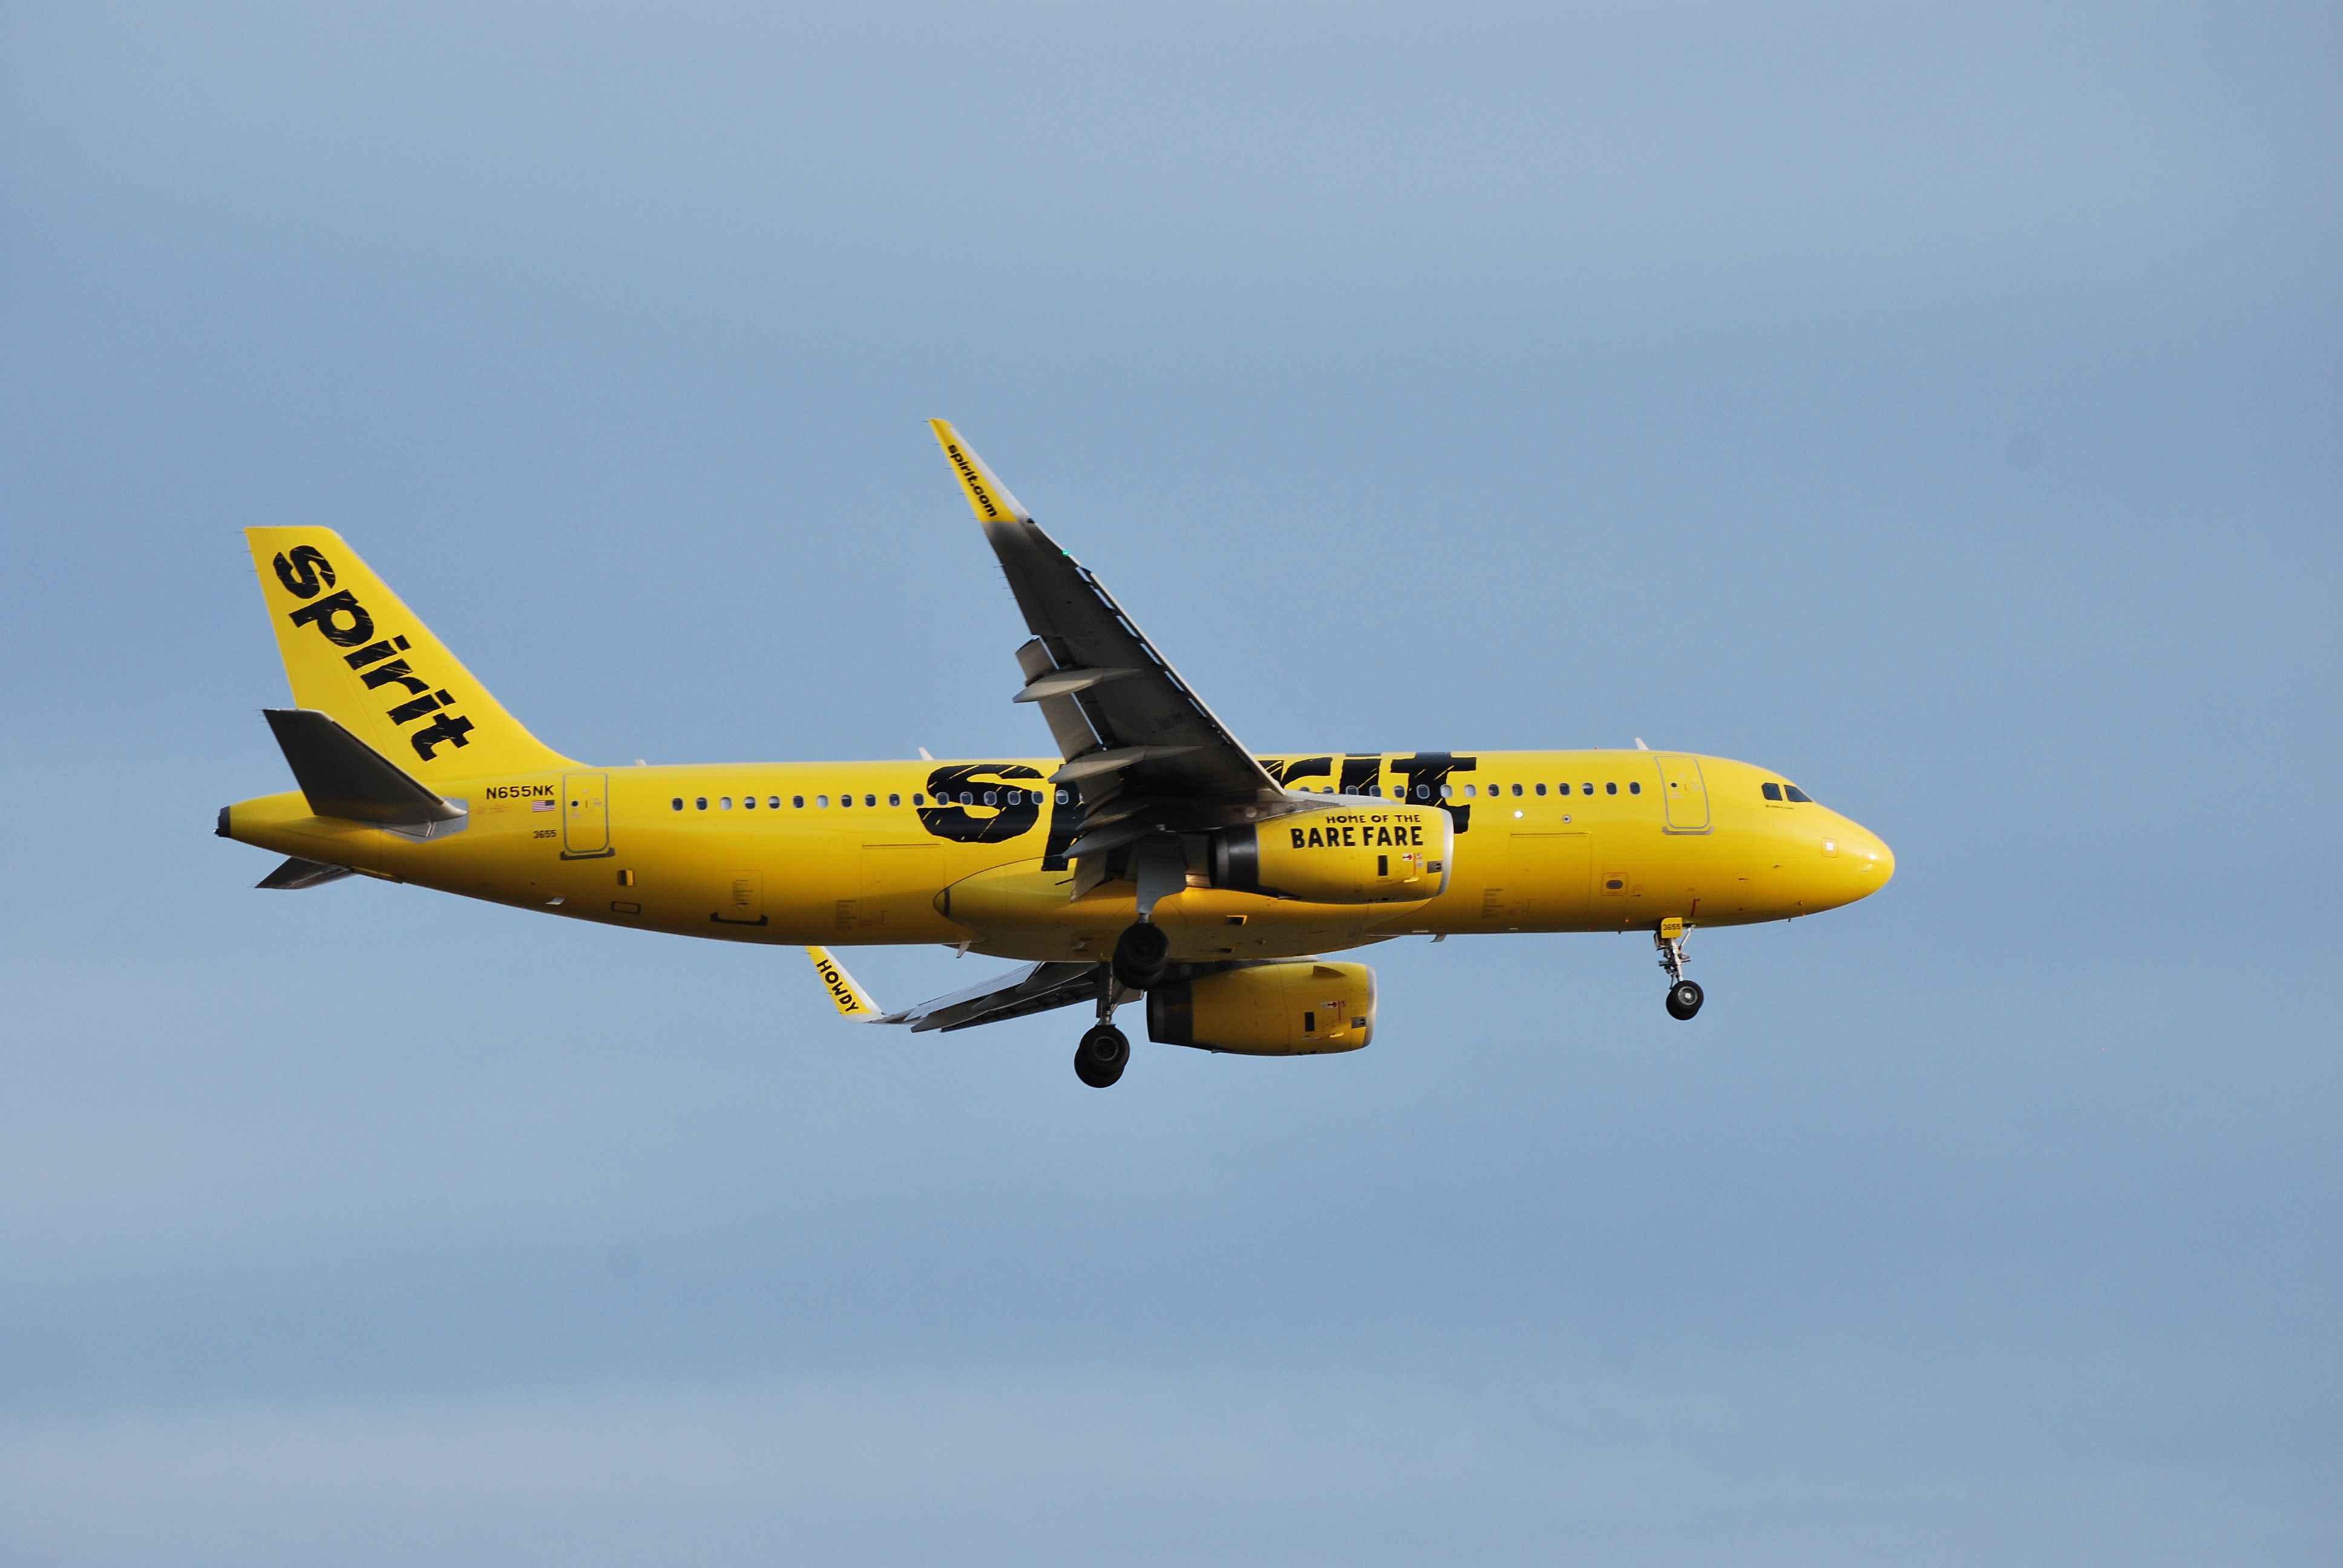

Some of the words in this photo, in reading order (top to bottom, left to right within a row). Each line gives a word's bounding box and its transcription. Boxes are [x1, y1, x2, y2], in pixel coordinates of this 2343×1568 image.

[947, 445, 997, 517] spirit.com
[273, 545, 474, 762] spirit
[487, 785, 554, 800] N655NK
[1326, 815, 1366, 824] HOME
[1371, 815, 1389, 823] OF
[1394, 814, 1421, 823] THE
[533, 829, 557, 838] 3655
[1290, 826, 1356, 849] BARE
[1363, 826, 1423, 846] FARE
[816, 959, 859, 1011] HOWDY
